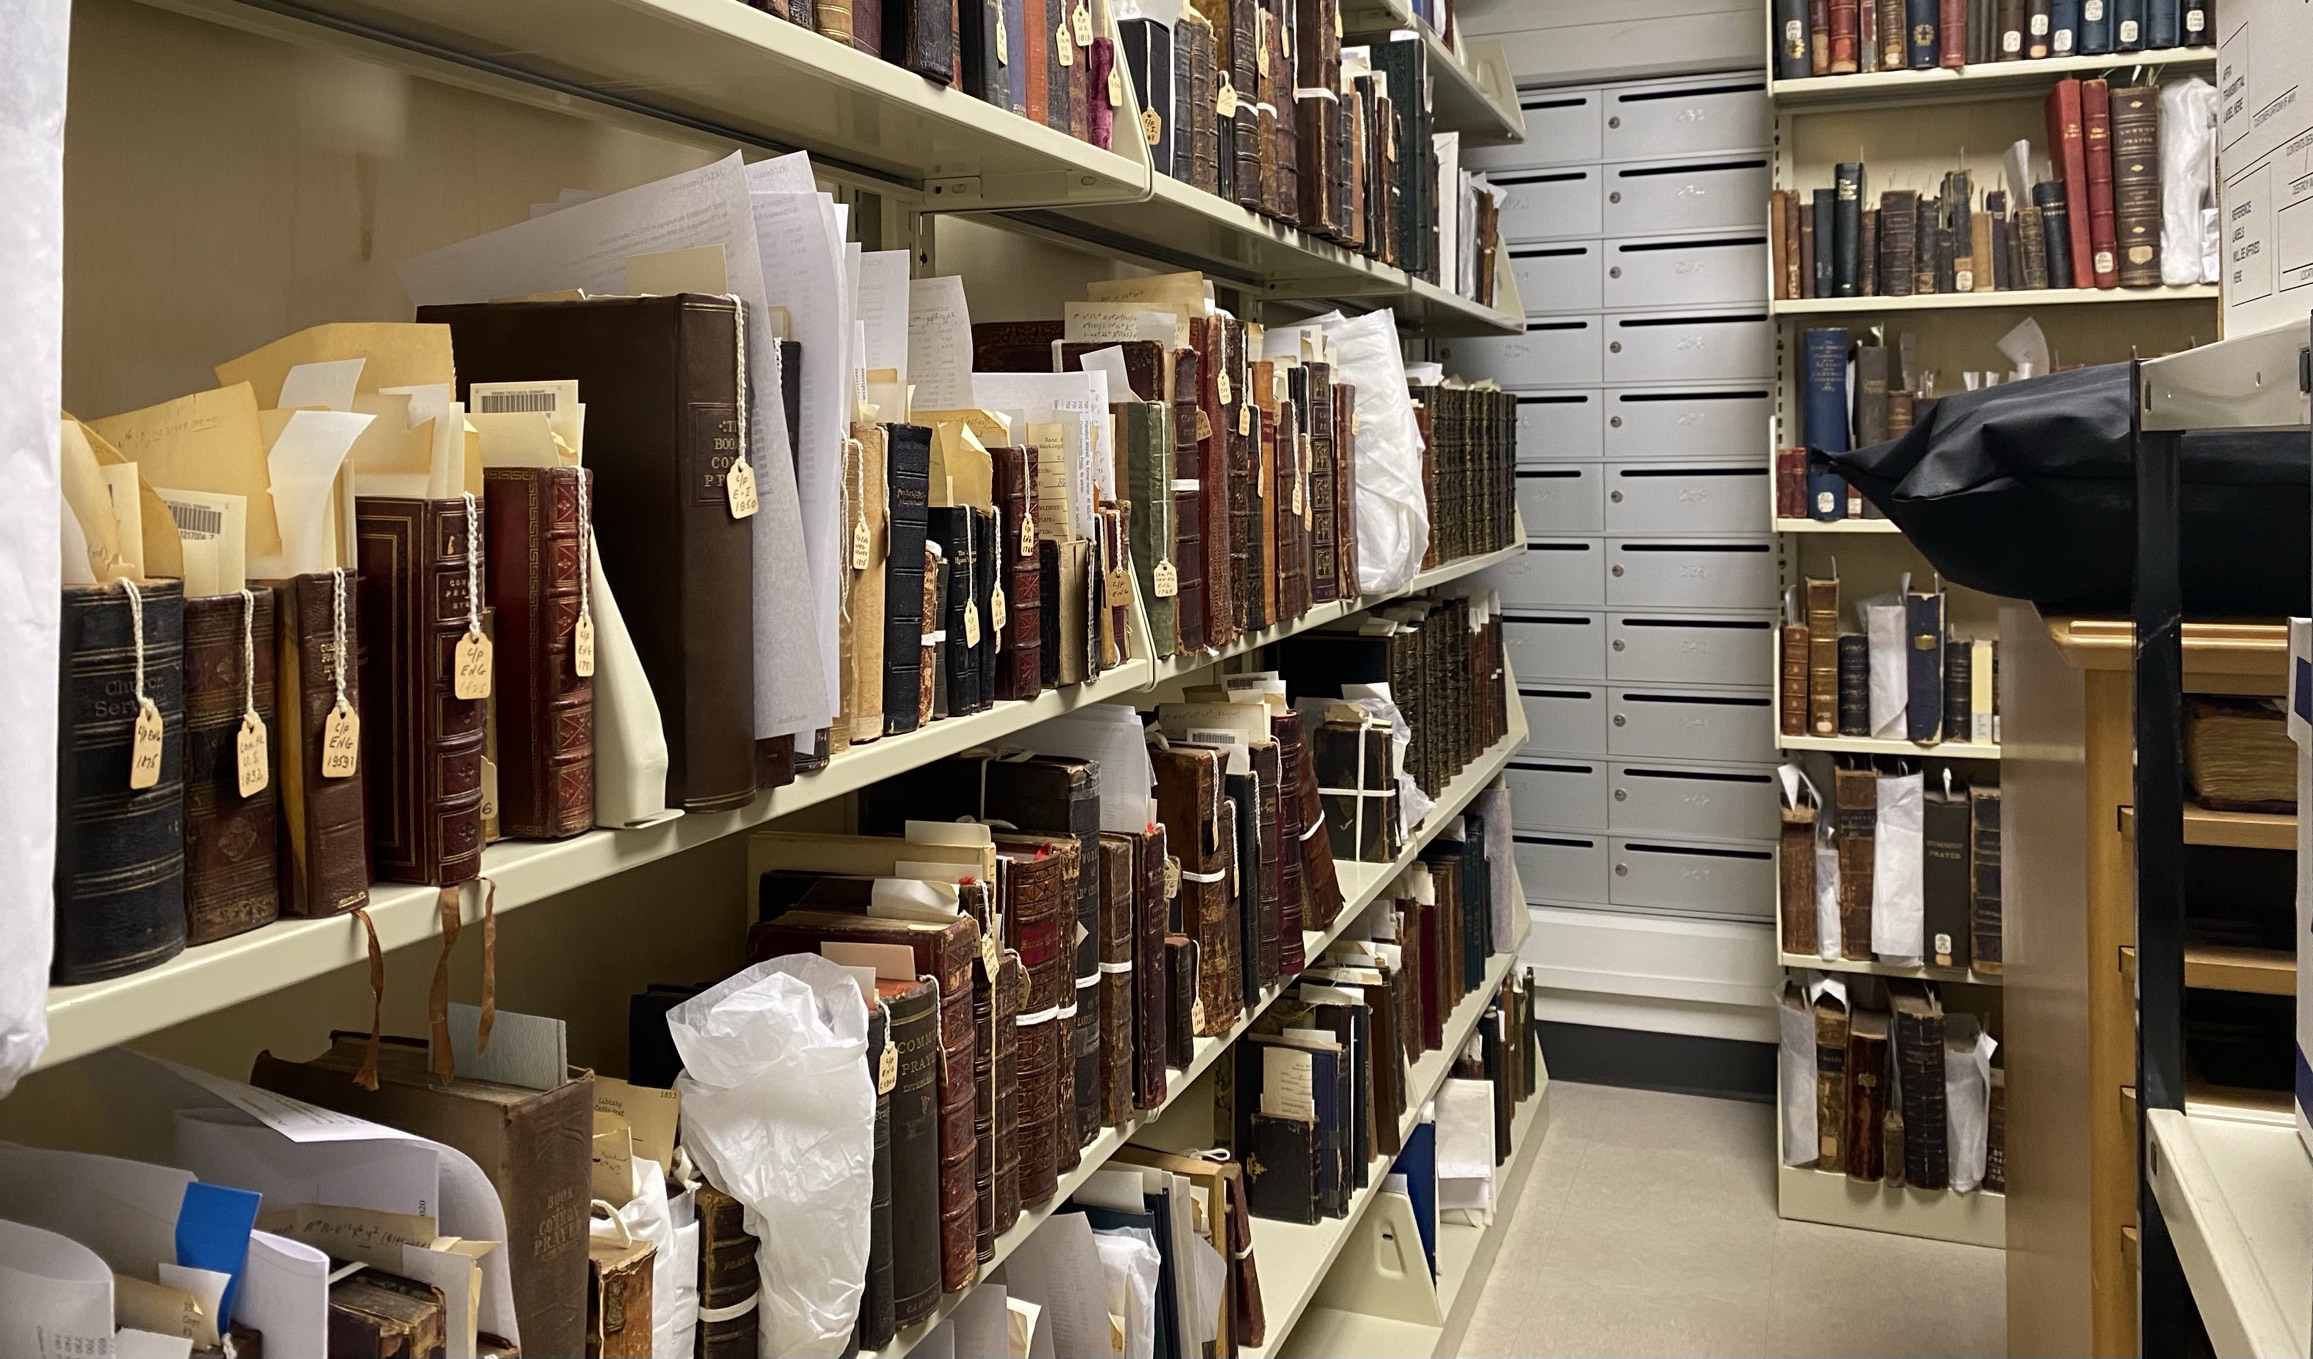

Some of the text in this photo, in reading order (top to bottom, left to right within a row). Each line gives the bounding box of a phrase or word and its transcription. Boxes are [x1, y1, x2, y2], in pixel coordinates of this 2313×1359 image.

[735, 500, 757, 512] 1850
[460, 664, 487, 677] ENG
[335, 722, 349, 734] C/P
[329, 736, 354, 749] ENG
[897, 1029, 936, 1054] COMMO
[901, 1051, 936, 1076] PRAYE
[660, 1091, 677, 1100] 1853
[546, 1186, 573, 1209] BOOK
[539, 1204, 580, 1236] COMMON
[533, 1217, 582, 1257] PRAYER
